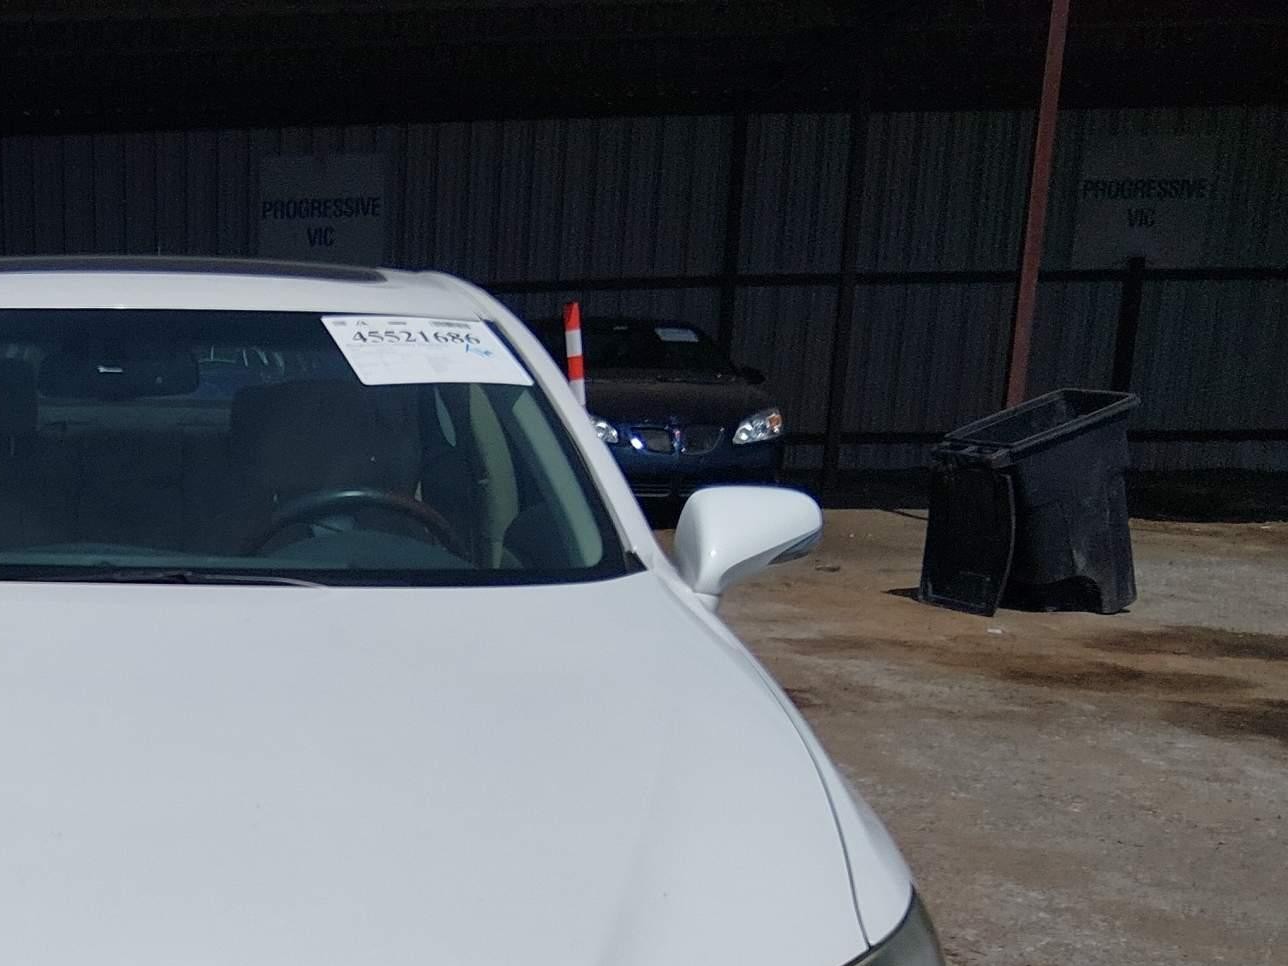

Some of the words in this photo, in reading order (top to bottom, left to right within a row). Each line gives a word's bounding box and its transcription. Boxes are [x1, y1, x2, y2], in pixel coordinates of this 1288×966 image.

[1082, 178, 1209, 199] PROGRESSIVE
[262, 197, 382, 219] PROGRESSIVE
[306, 226, 336, 247] VIC
[352, 330, 481, 345] 45521686
